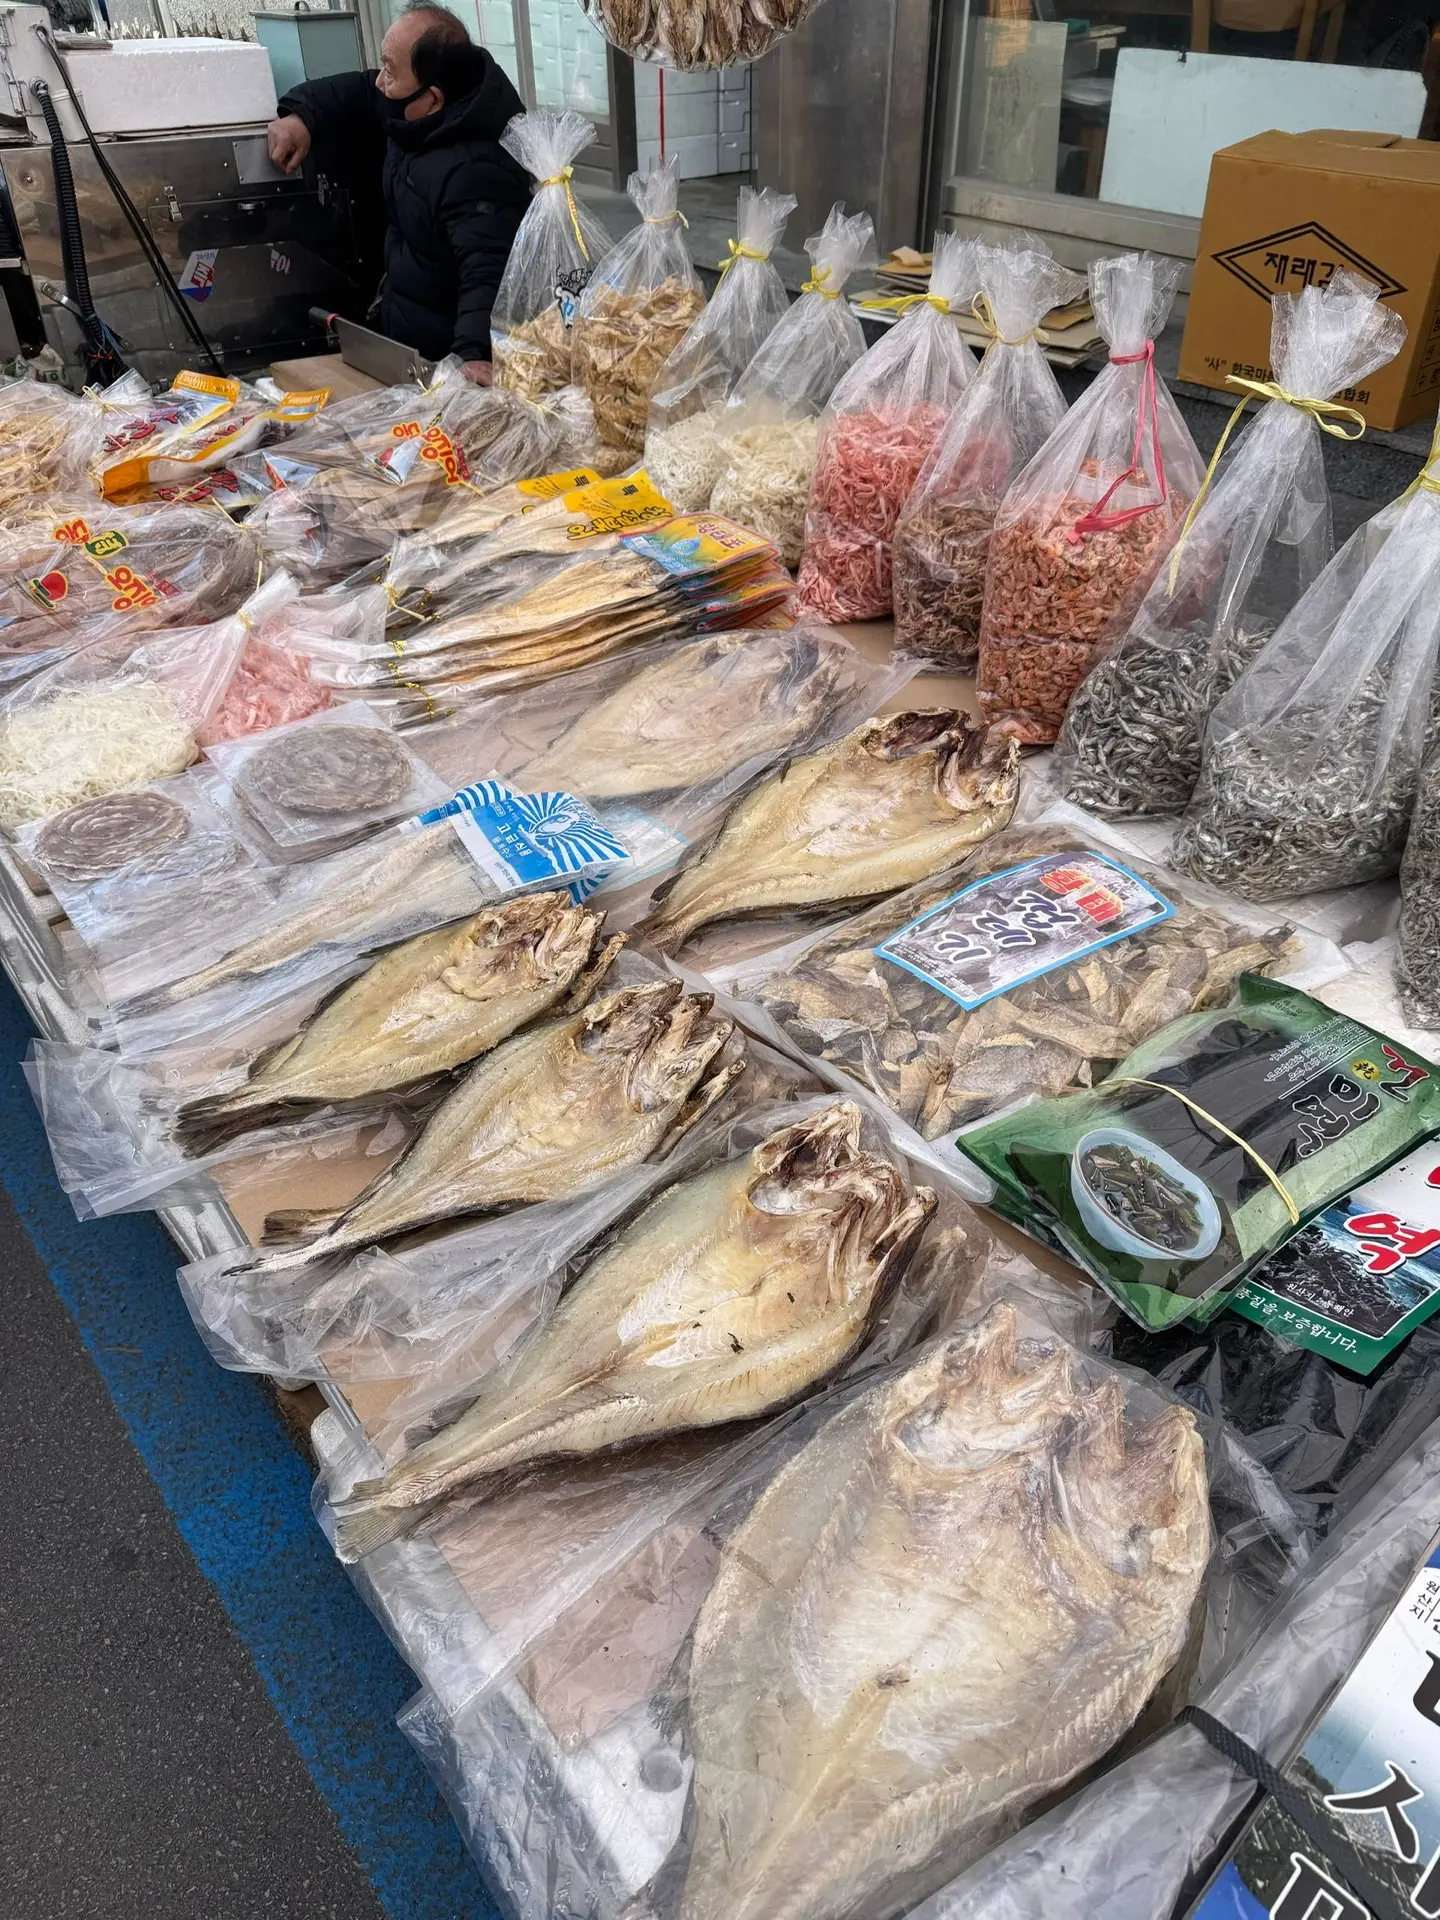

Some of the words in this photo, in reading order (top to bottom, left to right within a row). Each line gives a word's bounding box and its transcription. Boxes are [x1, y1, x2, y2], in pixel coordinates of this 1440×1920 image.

[1039, 868, 1124, 923] 황태
[1236, 1287, 1279, 1315] 품질을
[1278, 1310, 1357, 1354] 보증합니다.
